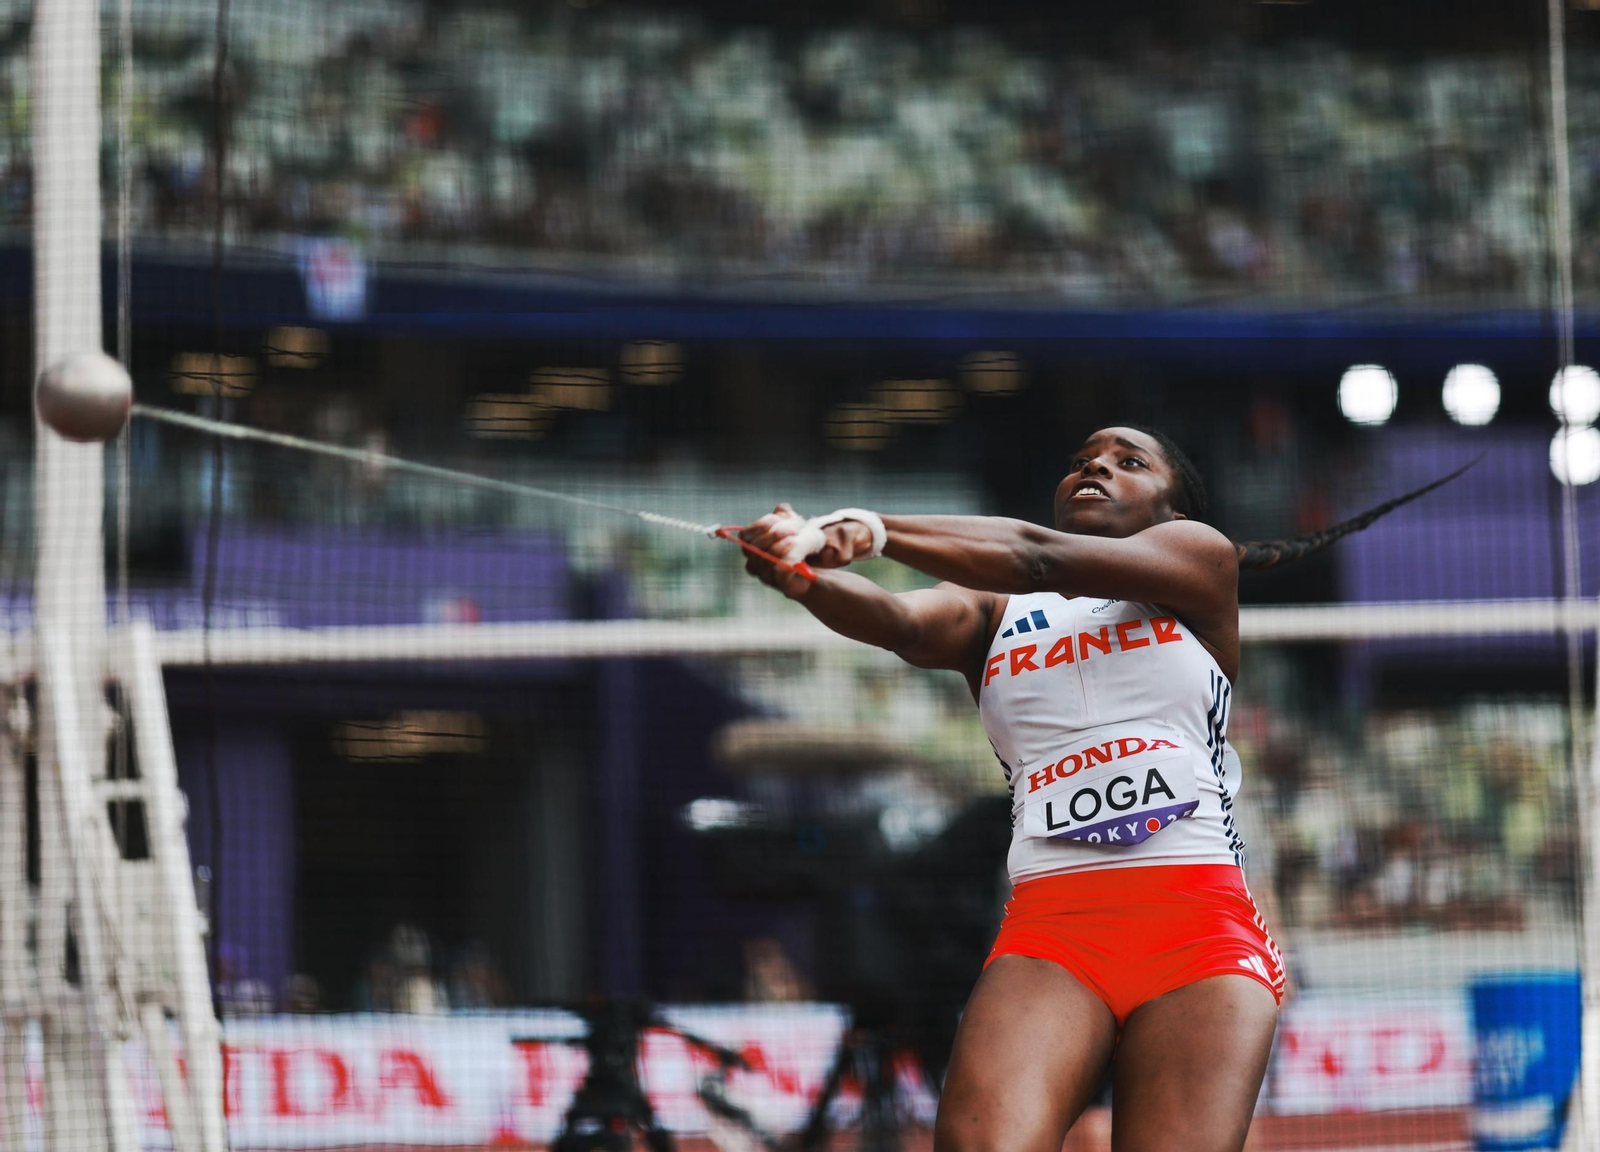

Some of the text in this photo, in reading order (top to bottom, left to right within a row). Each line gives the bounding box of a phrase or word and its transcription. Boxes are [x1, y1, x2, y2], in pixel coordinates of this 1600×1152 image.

[984, 616, 1183, 687] FRANCE
[1028, 737, 1184, 794] HONDA
[1045, 767, 1176, 831] LOGA
